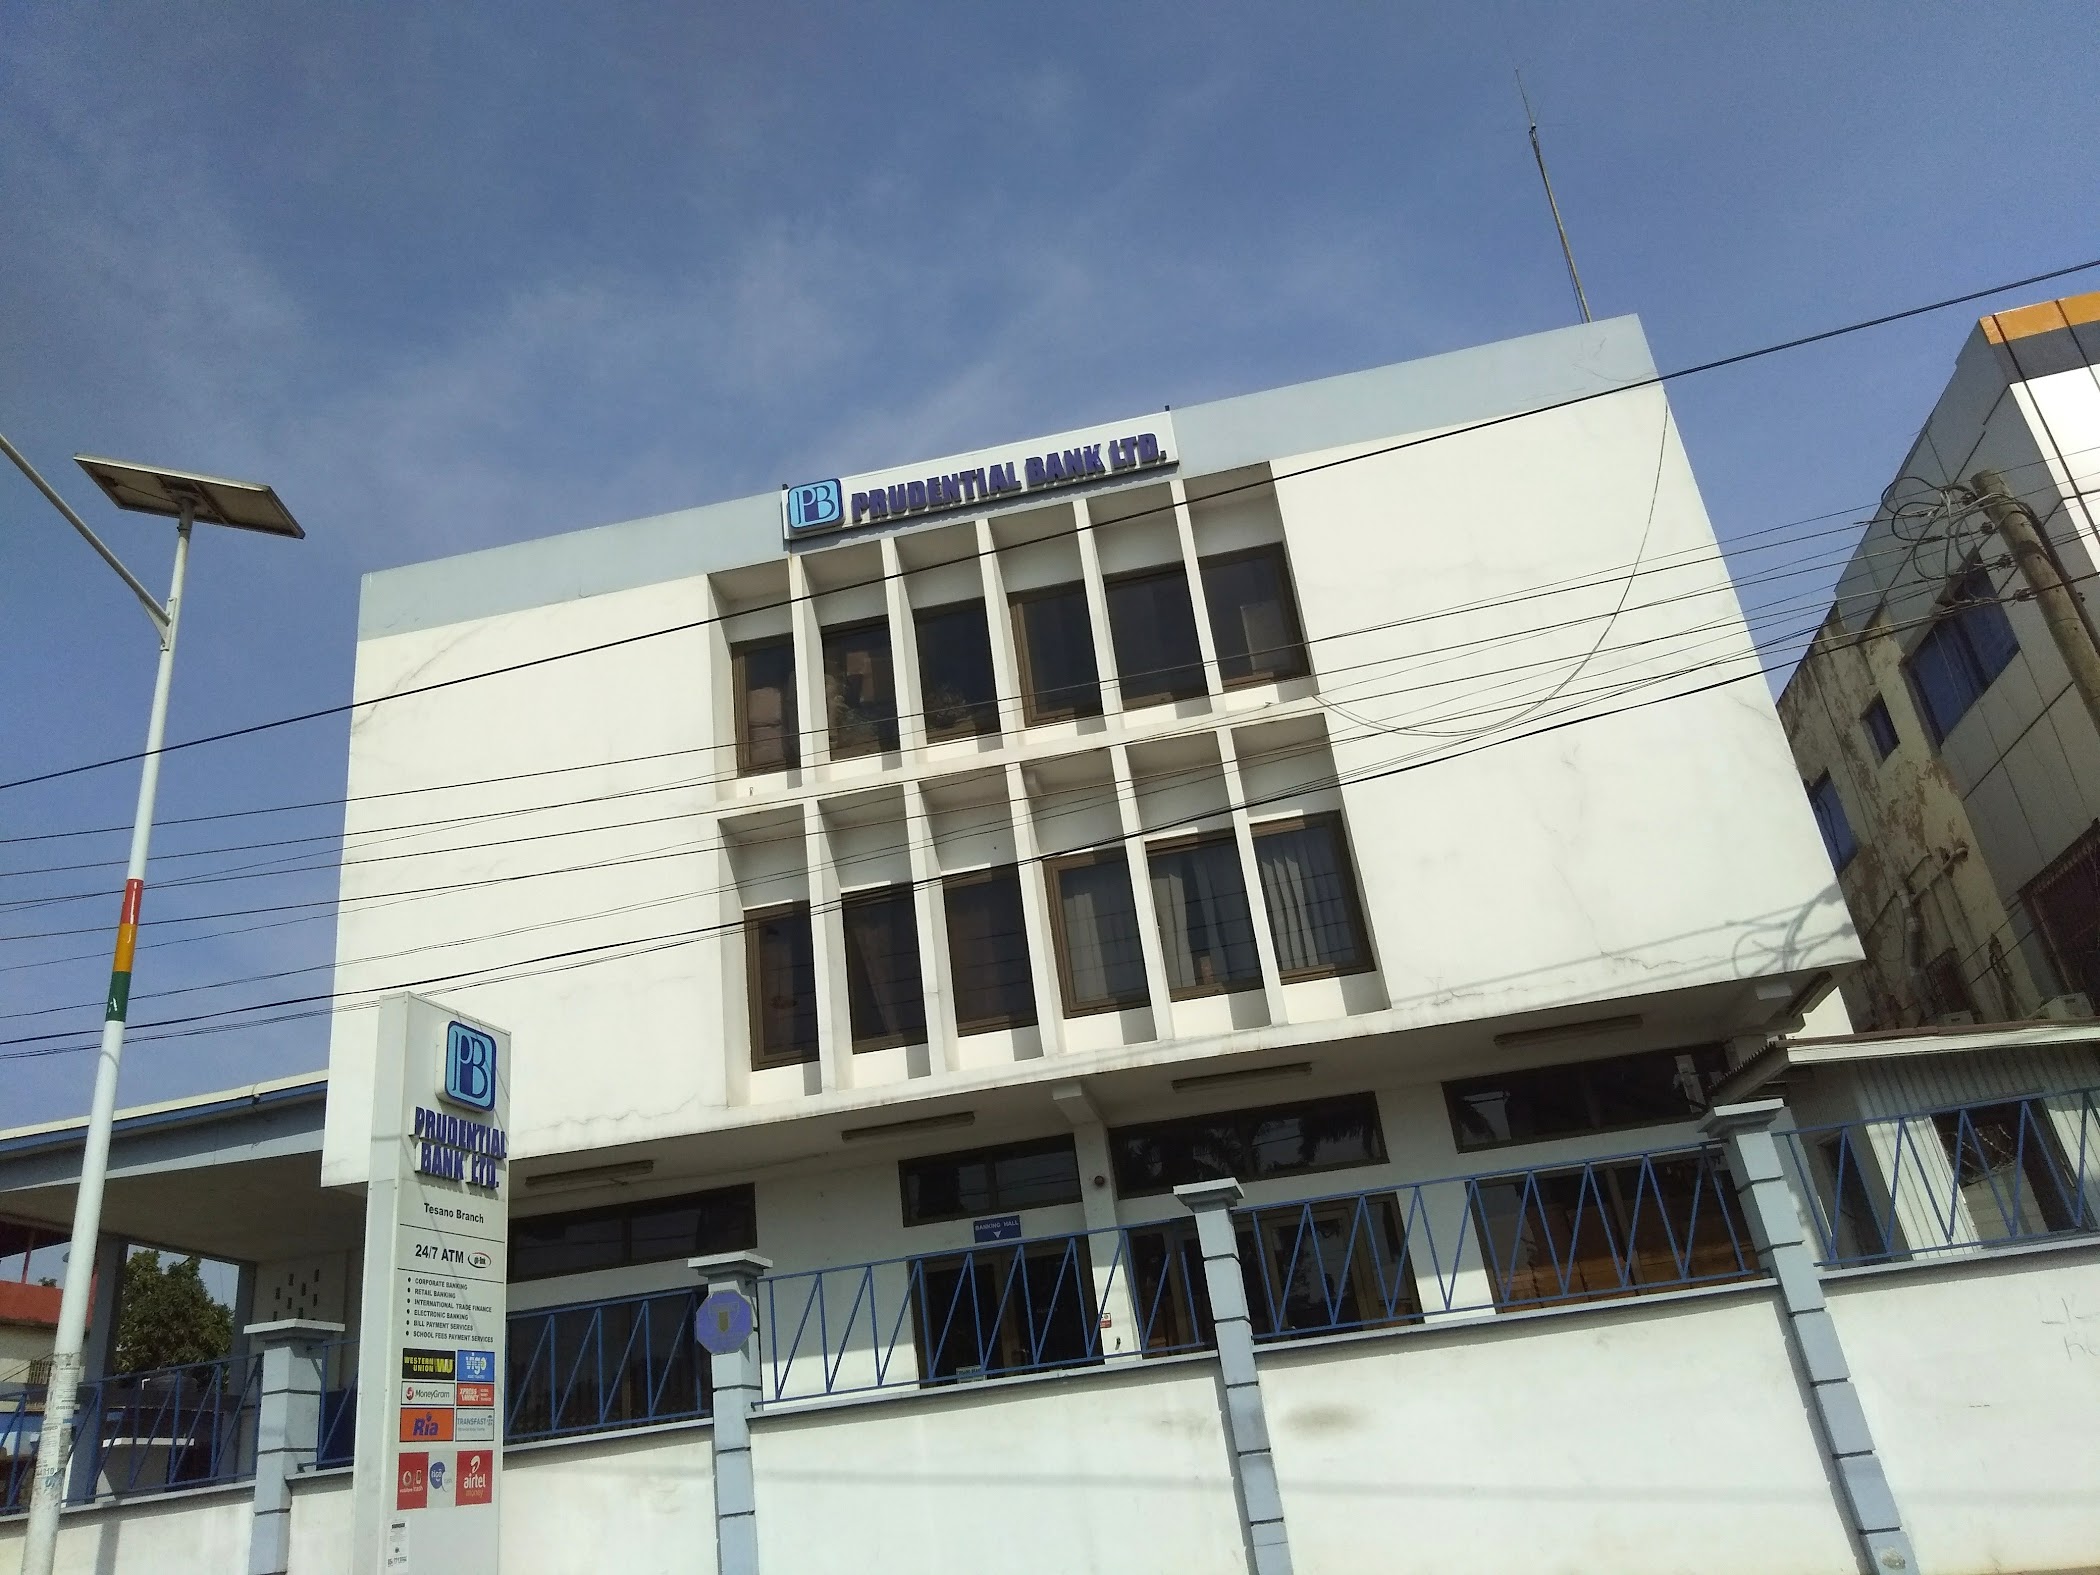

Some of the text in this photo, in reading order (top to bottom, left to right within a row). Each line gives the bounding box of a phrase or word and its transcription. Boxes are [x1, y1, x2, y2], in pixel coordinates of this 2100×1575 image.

[851, 433, 1167, 523] PRUDENTIAL BANK LTD.
[415, 1106, 507, 1160] PRUDENTIAL
[420, 1141, 499, 1189] BANK LTD.
[424, 1203, 484, 1223] Tesano Branch
[975, 1222, 1001, 1231] BANKING
[415, 1244, 464, 1264] 24/7 ATM
[414, 1278, 468, 1290] CORPORATE BANKING
[414, 1288, 456, 1299] RETAIL BANKING
[414, 1299, 492, 1313] INTERNATIONAL TRADE FINANCE
[414, 1309, 469, 1321] ELECTRONIC BANKING
[426, 1321, 449, 1329] PAYMENT
[450, 1323, 474, 1332] SERVICES
[413, 1331, 494, 1343] SCHOOL FEES PAYMENT SERVICES
[404, 1356, 434, 1365] WESTERN
[413, 1364, 434, 1372] UNION
[415, 1389, 450, 1400] MoneyGram
[412, 1411, 439, 1436] Ria
[457, 1418, 486, 1426] TRANSFAST
[463, 1473, 486, 1489] airtel
